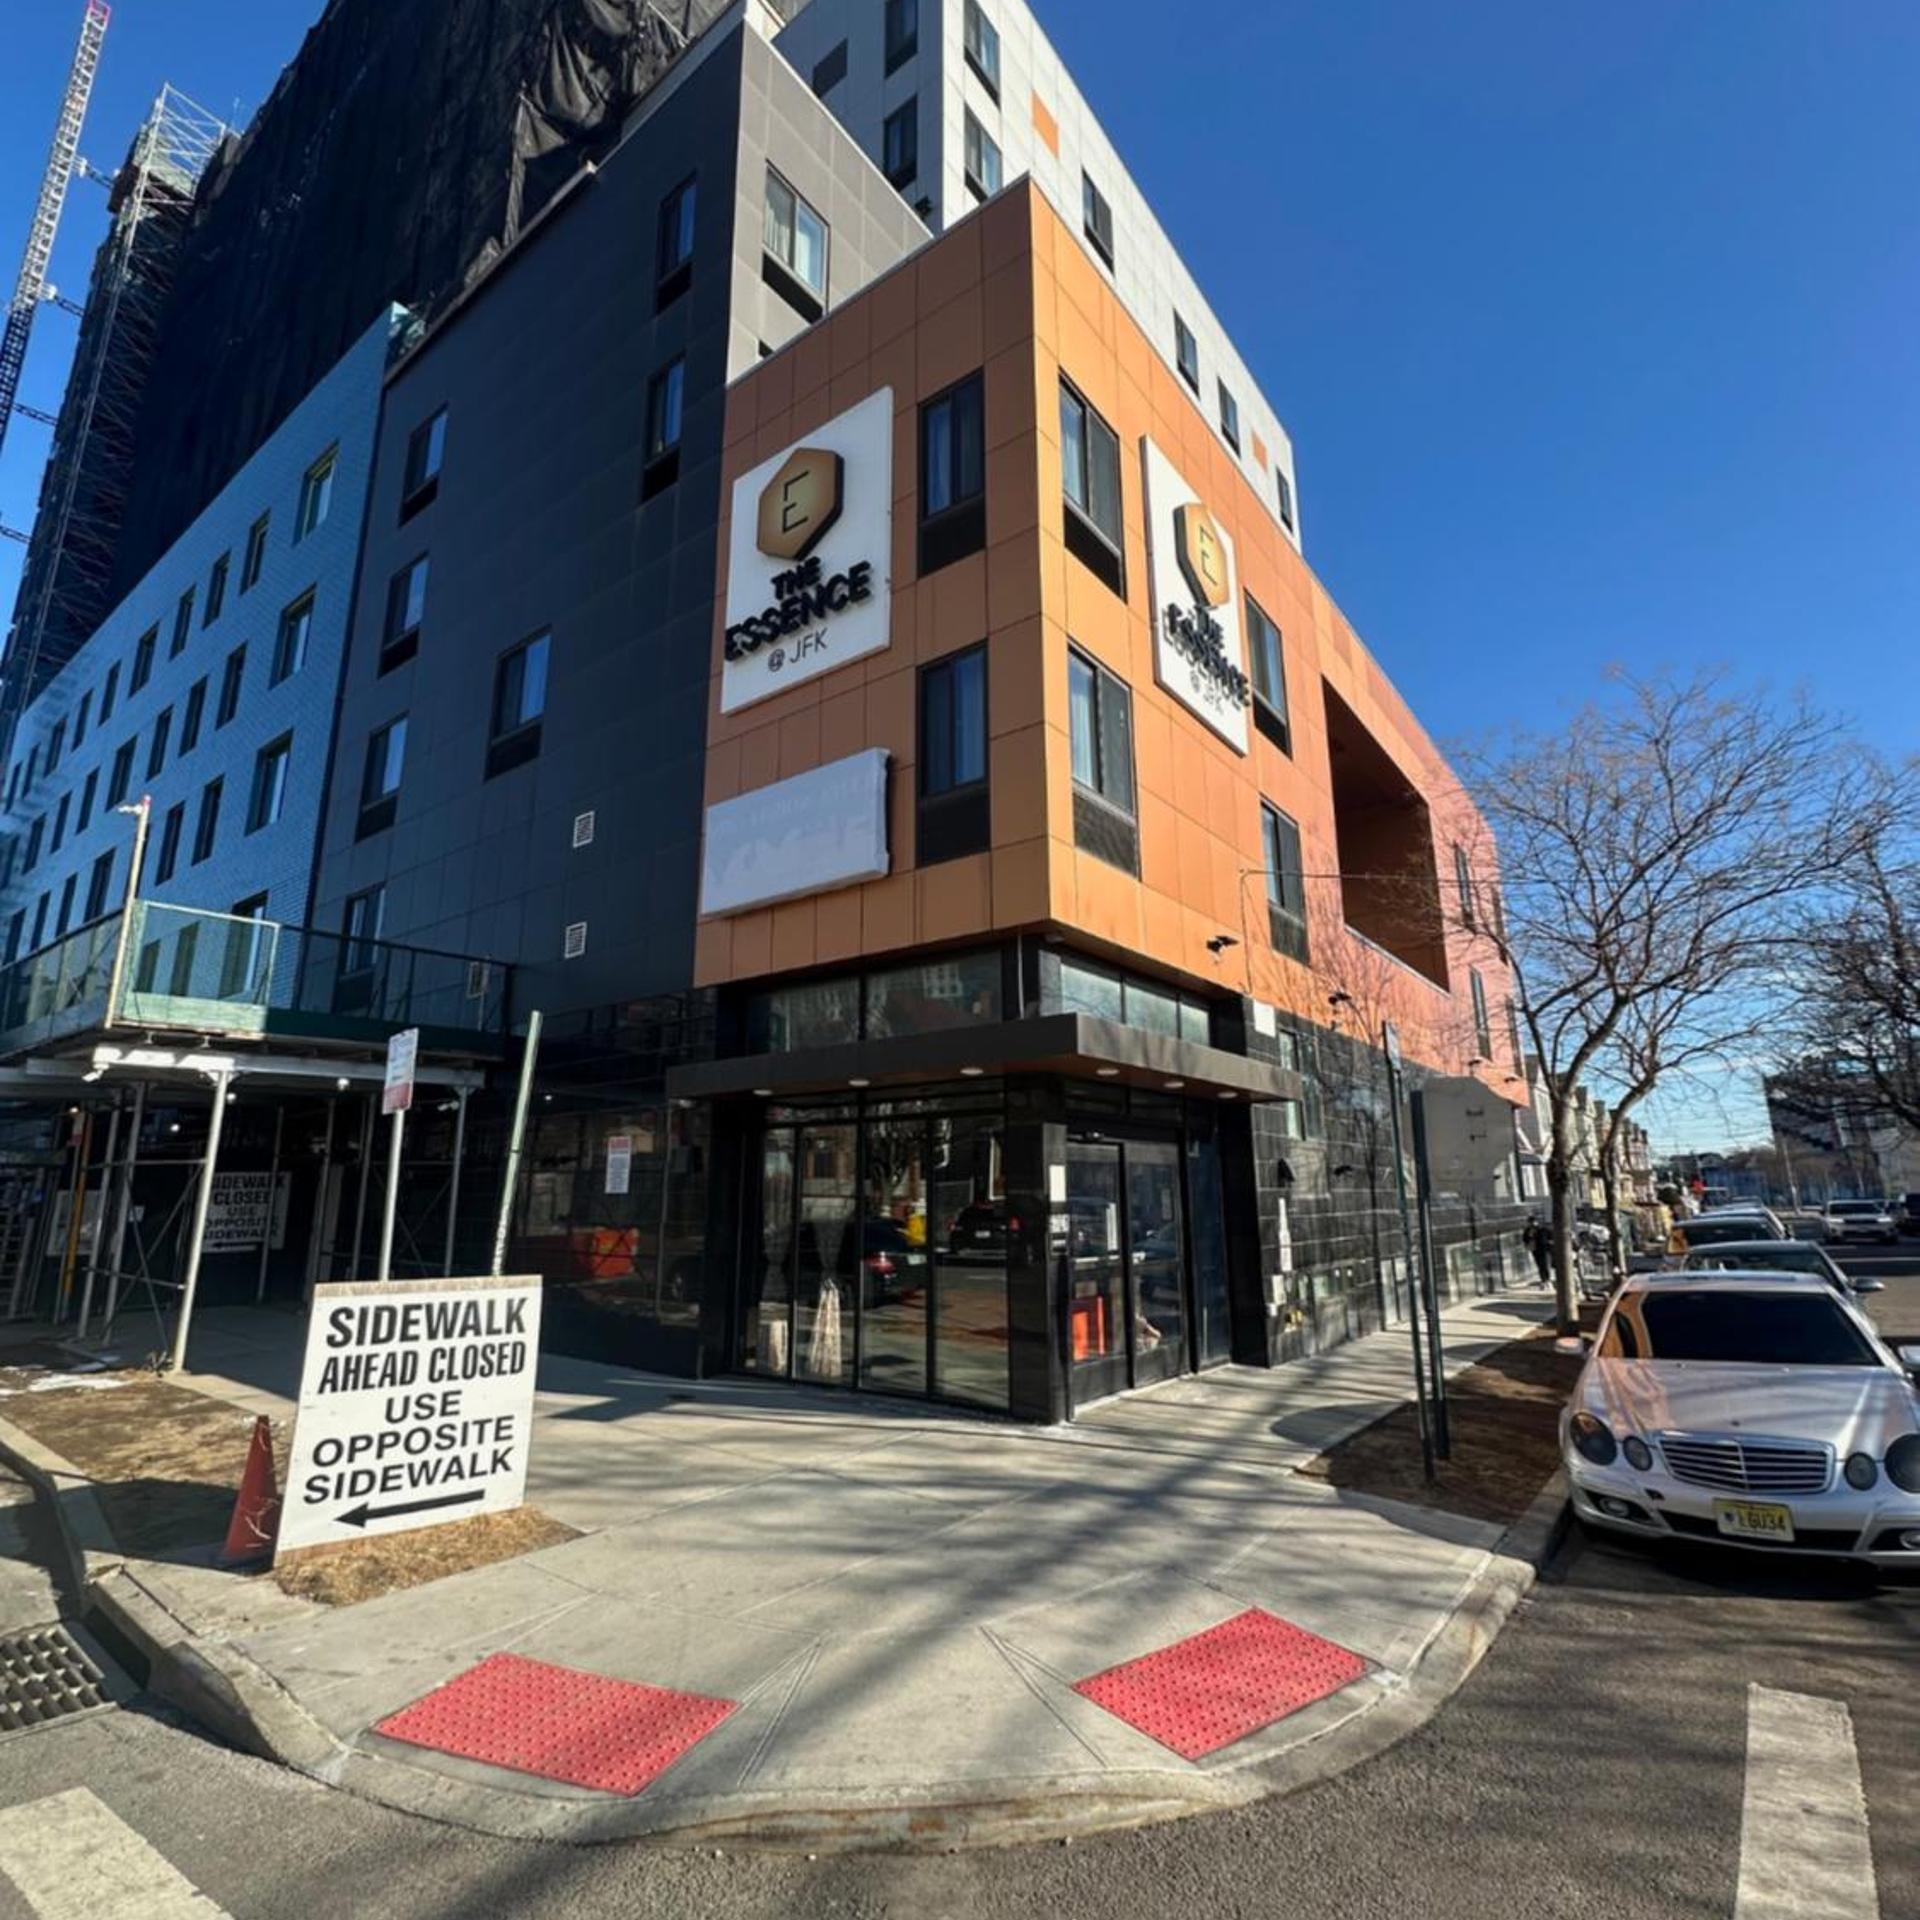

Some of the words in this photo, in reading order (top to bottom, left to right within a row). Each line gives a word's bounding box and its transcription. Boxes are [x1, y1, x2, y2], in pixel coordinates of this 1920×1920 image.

[771, 556, 821, 600] THE
[725, 560, 871, 662] ESSENCE
[789, 628, 828, 663] JFK
[326, 1297, 528, 1348] SIDEWALK
[317, 1350, 419, 1394] AHEAD
[428, 1341, 526, 1383] CLOSED
[385, 1390, 462, 1424] USE
[312, 1415, 515, 1468] OPPOSITE
[303, 1447, 514, 1505] SIDEWALK
